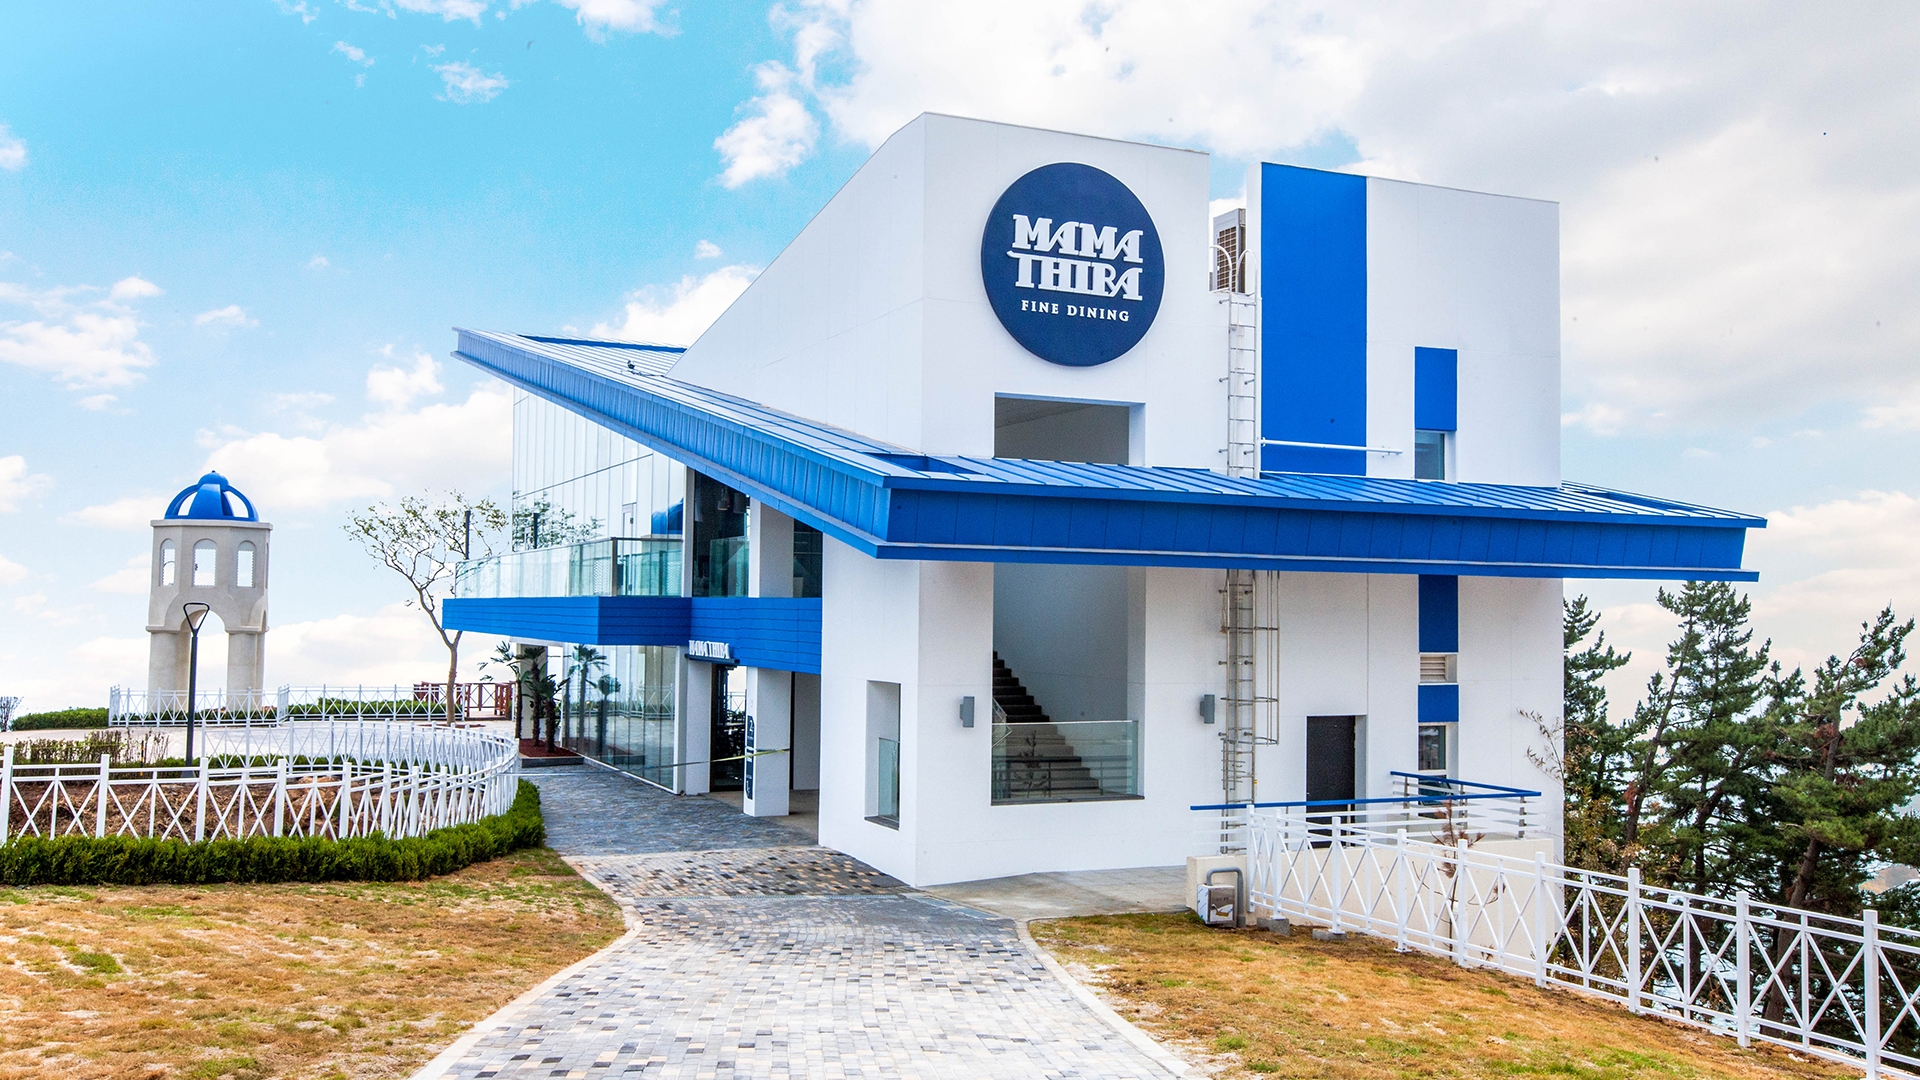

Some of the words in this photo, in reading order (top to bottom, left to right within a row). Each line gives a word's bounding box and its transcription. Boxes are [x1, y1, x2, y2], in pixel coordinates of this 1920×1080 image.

[1012, 214, 1143, 263] MAMA
[1006, 250, 1143, 300] THIRA
[1021, 300, 1059, 314] FINE
[1067, 304, 1129, 322] DINING
